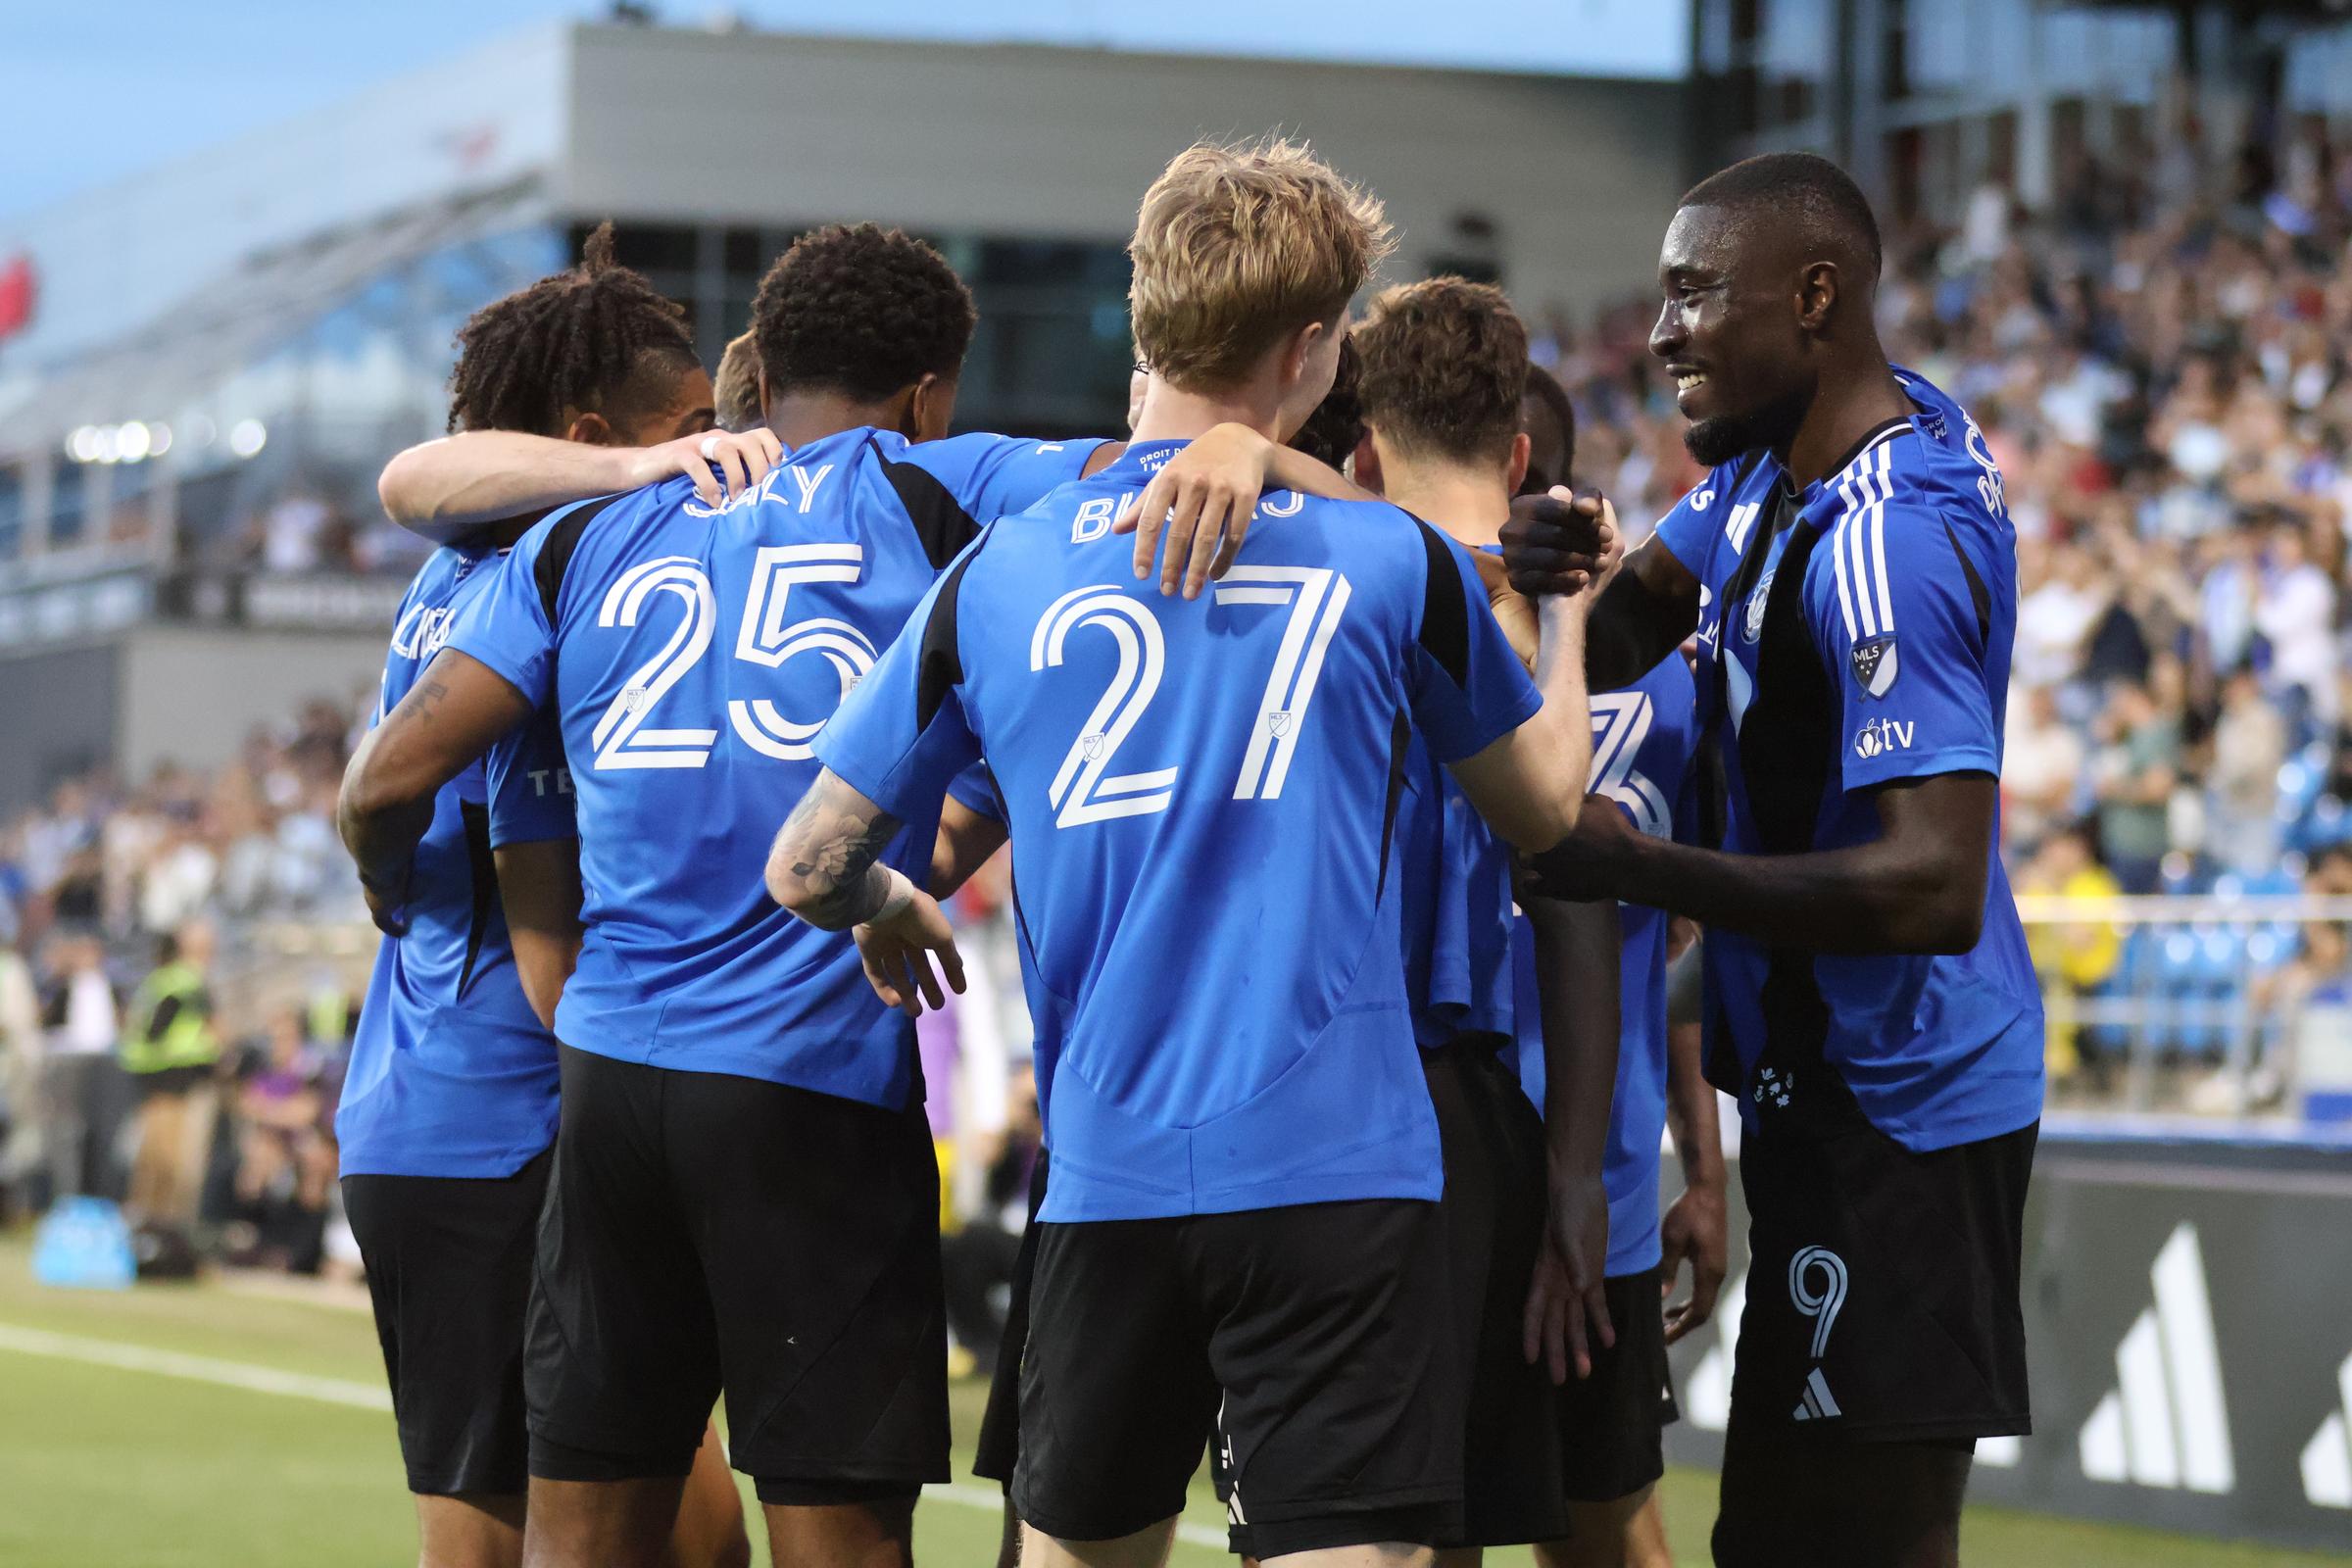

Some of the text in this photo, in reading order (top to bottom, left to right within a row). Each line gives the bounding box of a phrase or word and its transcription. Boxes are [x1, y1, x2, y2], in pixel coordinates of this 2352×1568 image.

[1140, 449, 1170, 465] DROIT
[591, 543, 879, 770] 25
[1852, 645, 1881, 663] MLS
[1030, 564, 1352, 829] 27
[1882, 717, 1915, 752] tv
[1788, 1246, 1848, 1358] 9
